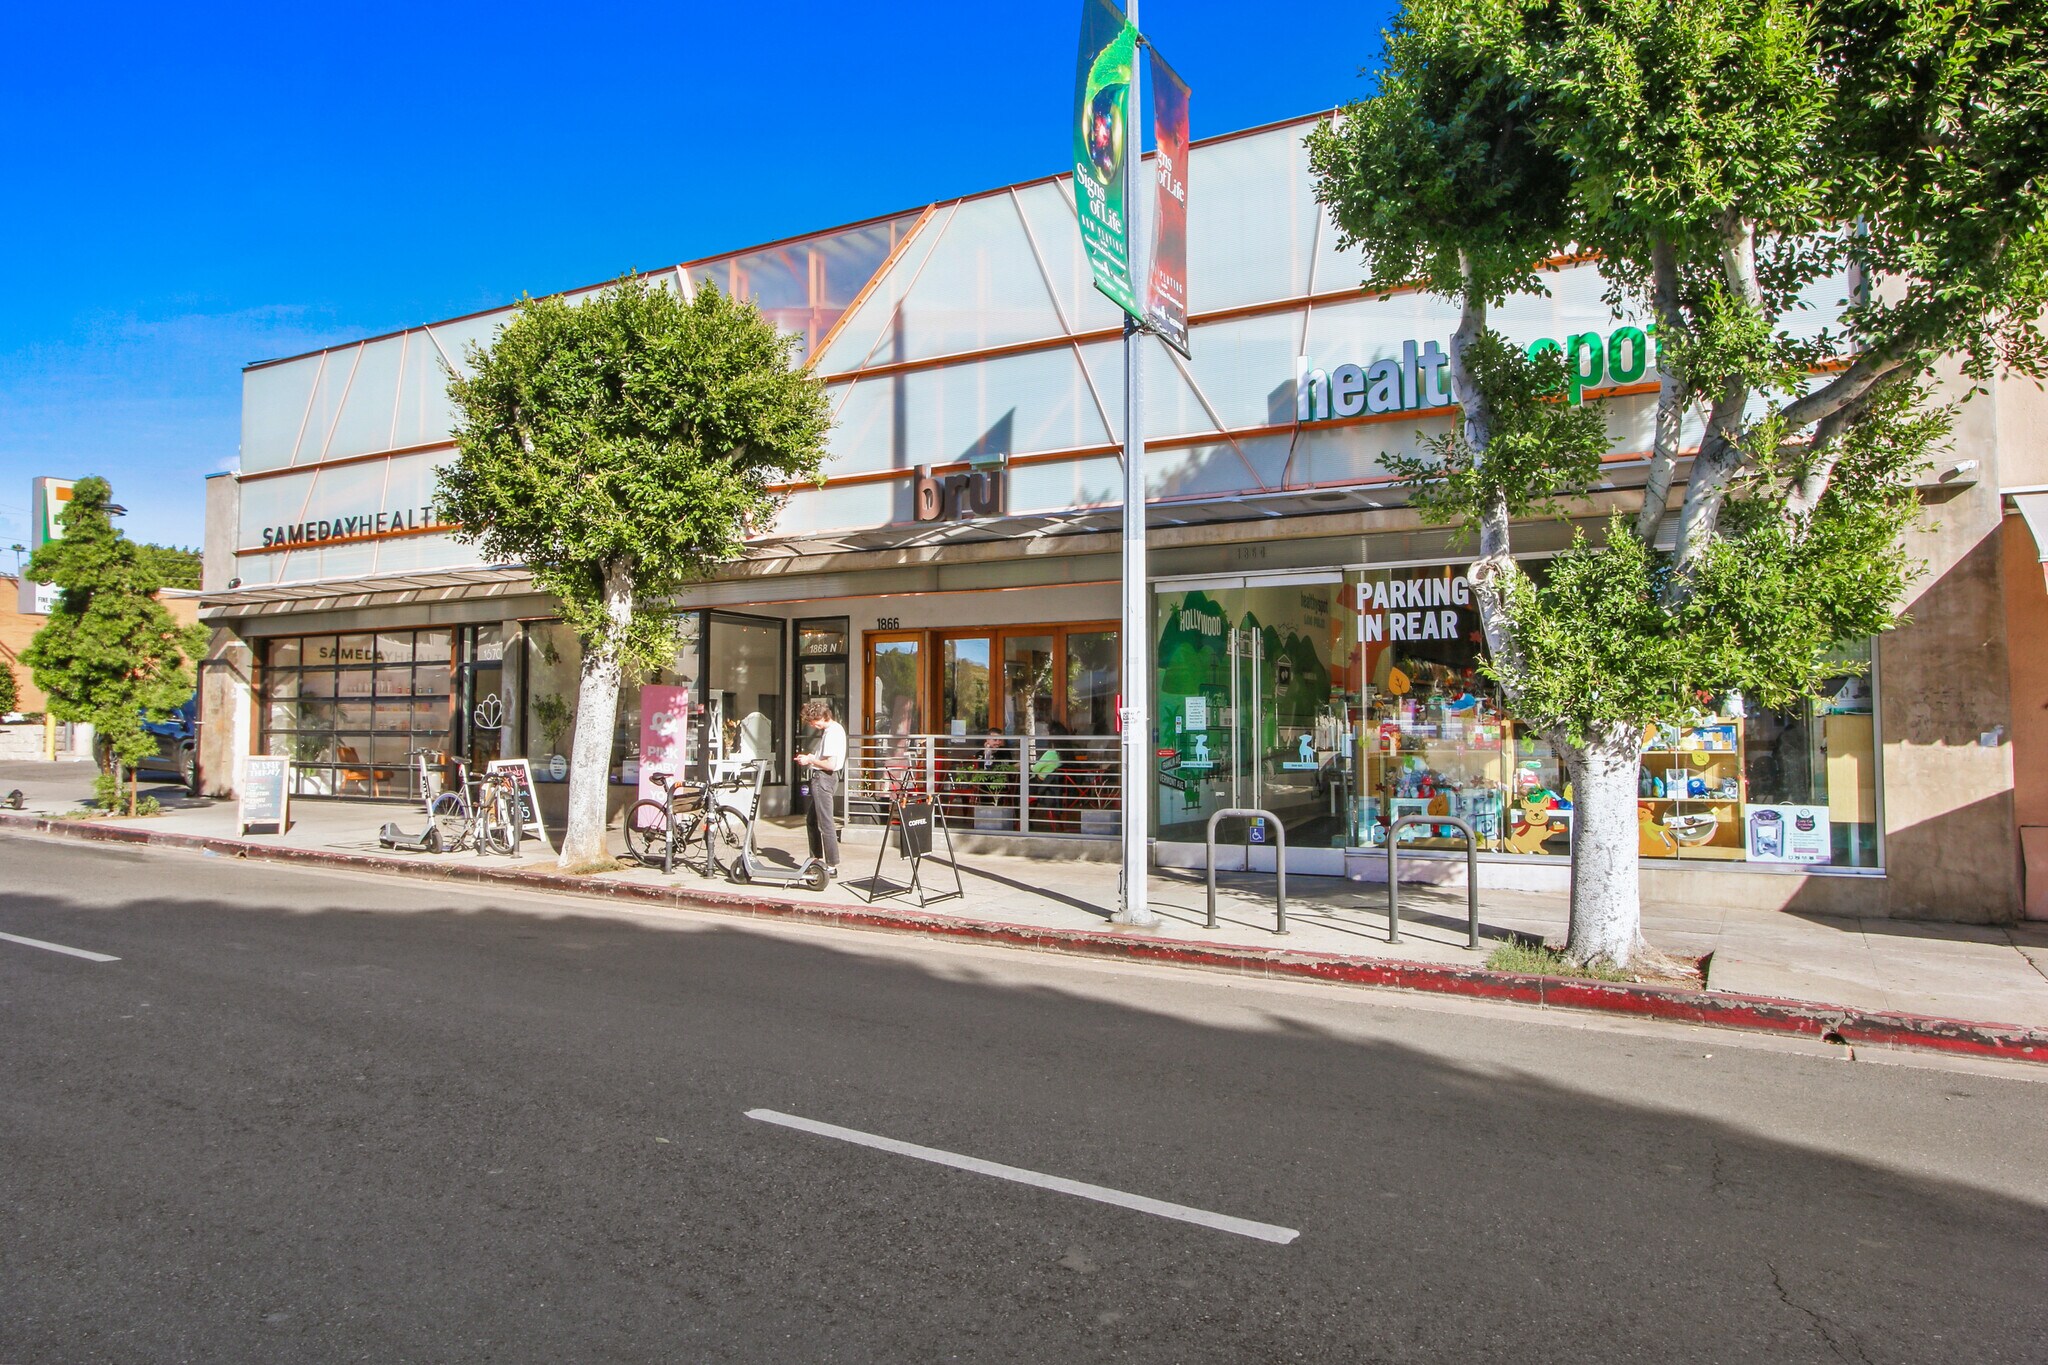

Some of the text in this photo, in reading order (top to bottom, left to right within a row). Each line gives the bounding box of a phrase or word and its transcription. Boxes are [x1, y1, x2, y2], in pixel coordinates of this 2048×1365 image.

[1077, 162, 1105, 201] Signs
[1167, 172, 1185, 202] Life
[1090, 199, 1121, 234] of Life
[1357, 576, 1469, 610] PARKING
[877, 618, 900, 630] 1866
[1180, 608, 1222, 637] HOLLYWOOD
[1357, 610, 1458, 642] IN REAR
[810, 643, 838, 653] 1868 N
[647, 746, 679, 759] PINK
